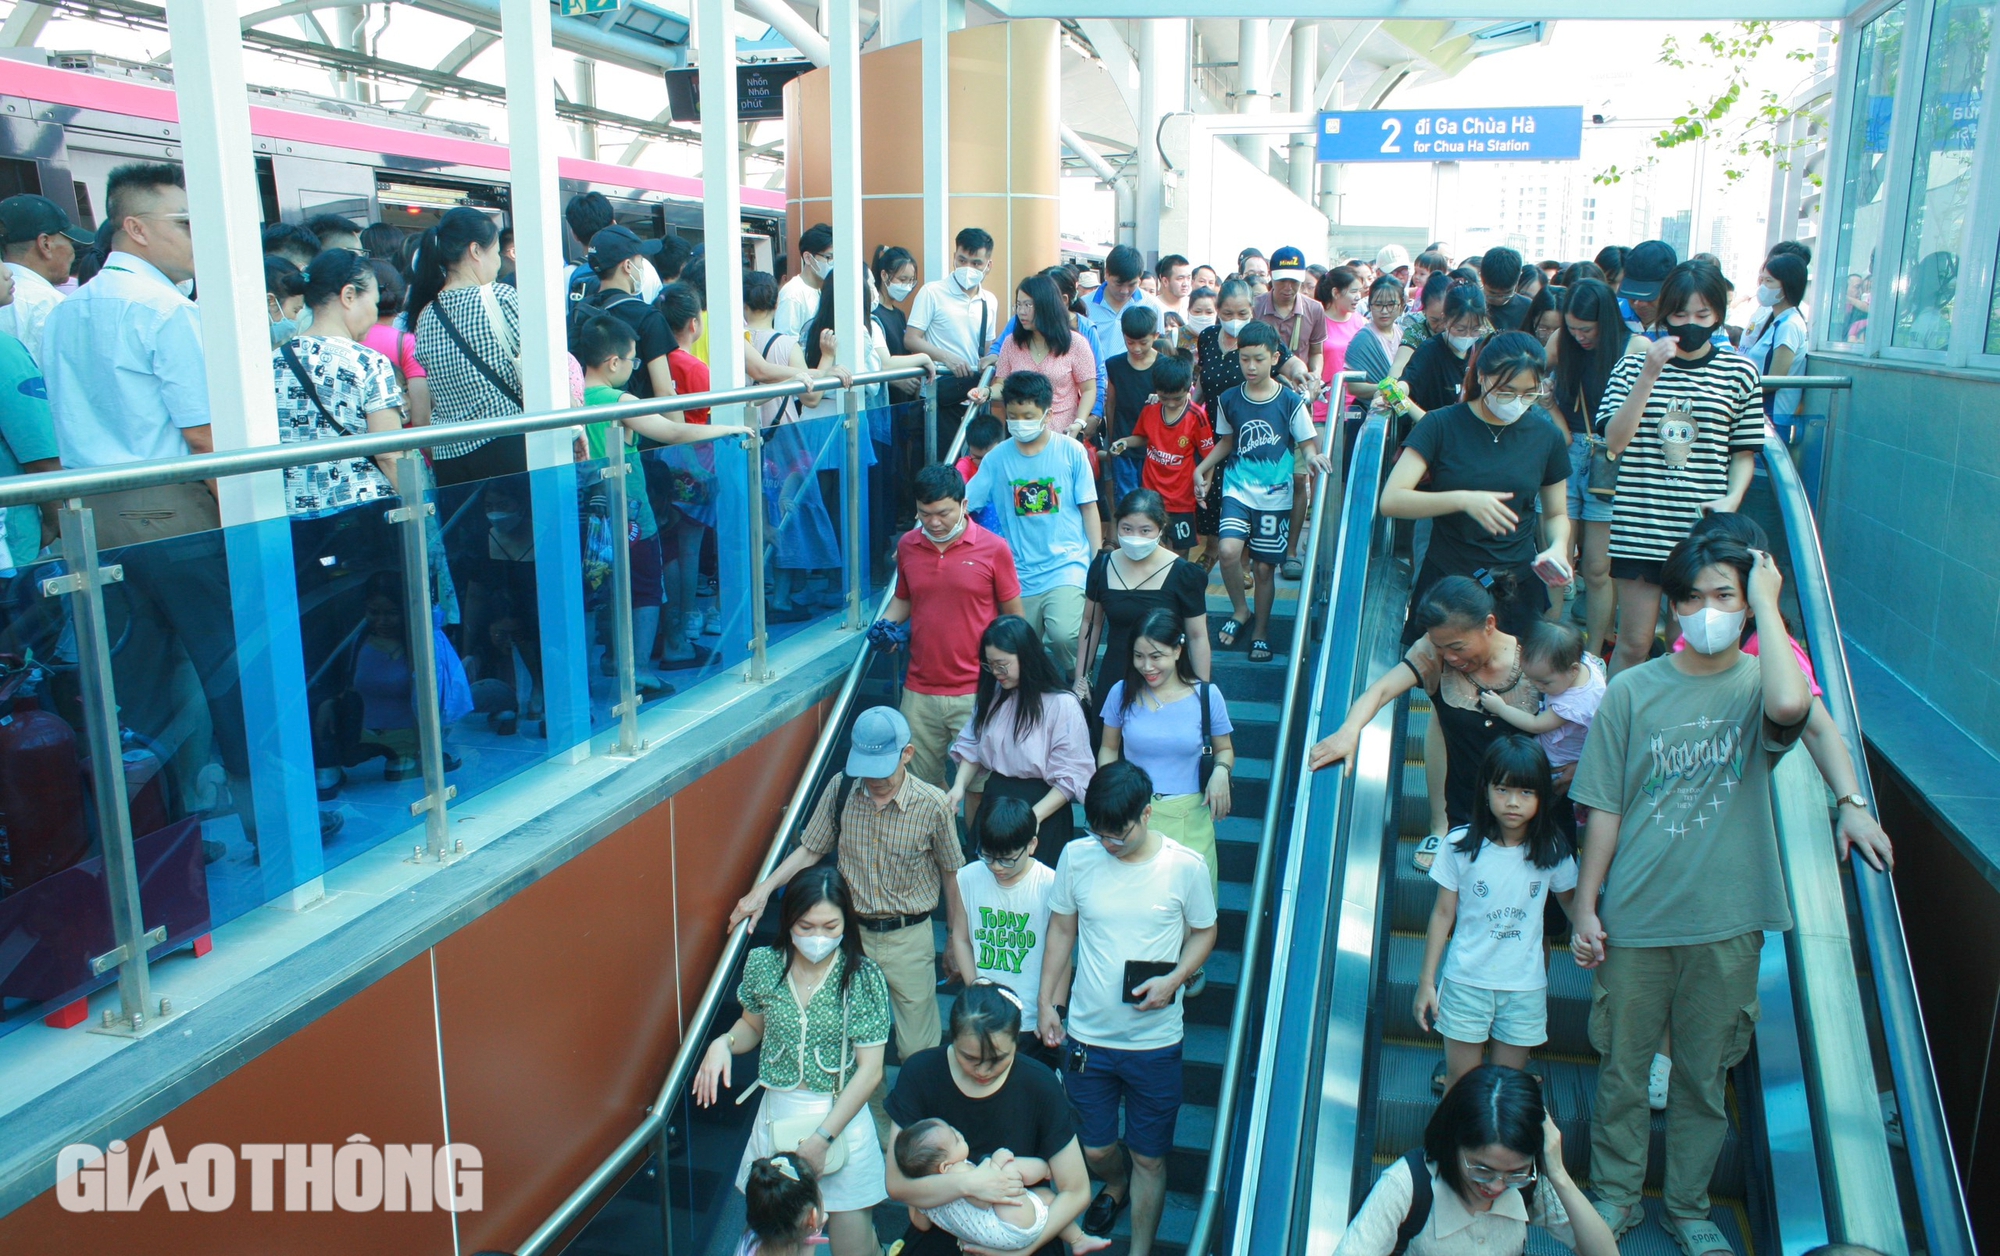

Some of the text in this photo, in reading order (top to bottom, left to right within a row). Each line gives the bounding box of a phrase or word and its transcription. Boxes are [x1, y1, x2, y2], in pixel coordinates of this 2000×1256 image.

[740, 98, 763, 110] phút
[1380, 117, 1401, 153] 2
[1415, 115, 1535, 135] đi Ga Chùa Hà
[1413, 139, 1530, 153] for Chua Ha Station
[1174, 521, 1190, 540] 10
[1260, 515, 1277, 536] 9
[979, 906, 1030, 932] TODAY
[975, 928, 1036, 948] IS A GOOD
[977, 942, 1029, 973] DAY
[1692, 1233, 1721, 1244] SPORT
